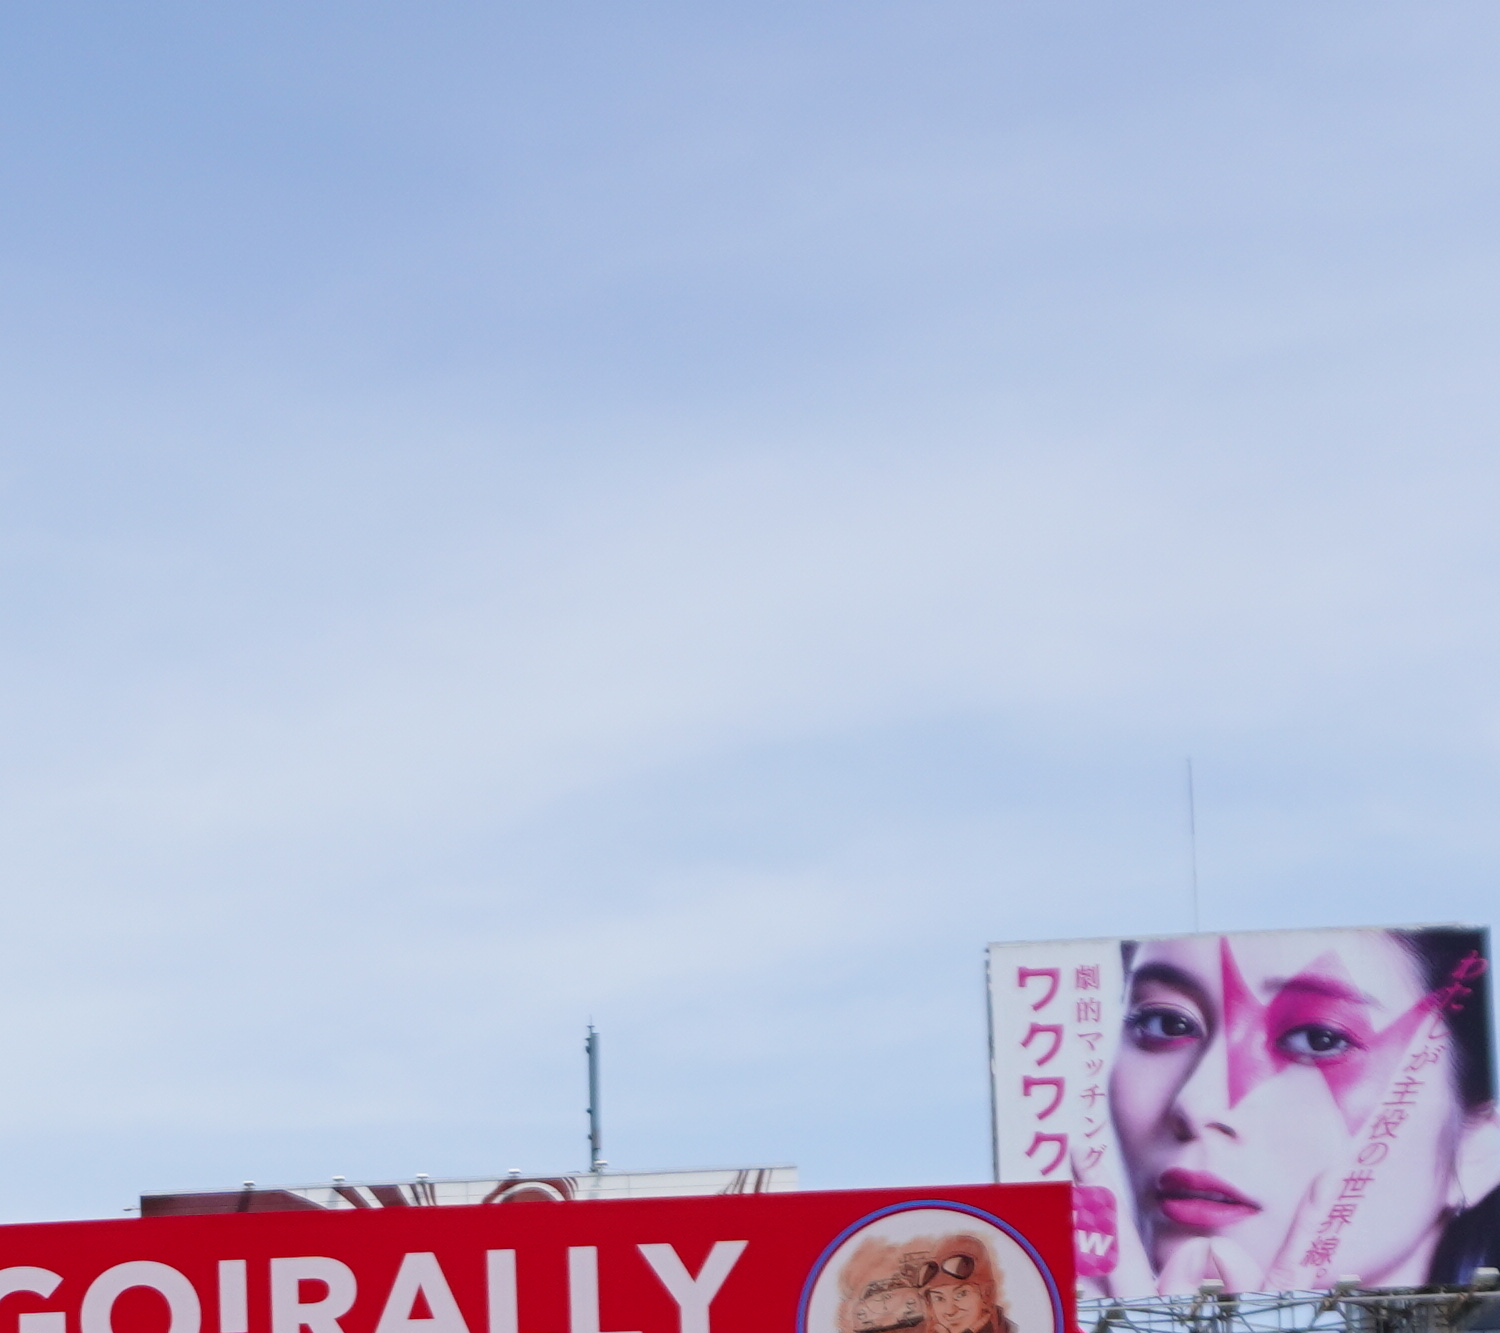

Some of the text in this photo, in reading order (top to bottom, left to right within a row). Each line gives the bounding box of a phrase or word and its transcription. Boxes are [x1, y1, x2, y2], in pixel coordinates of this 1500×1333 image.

[1016, 966, 1069, 1177] ワクワク
[1074, 963, 1108, 1170] 劇的マッチング
